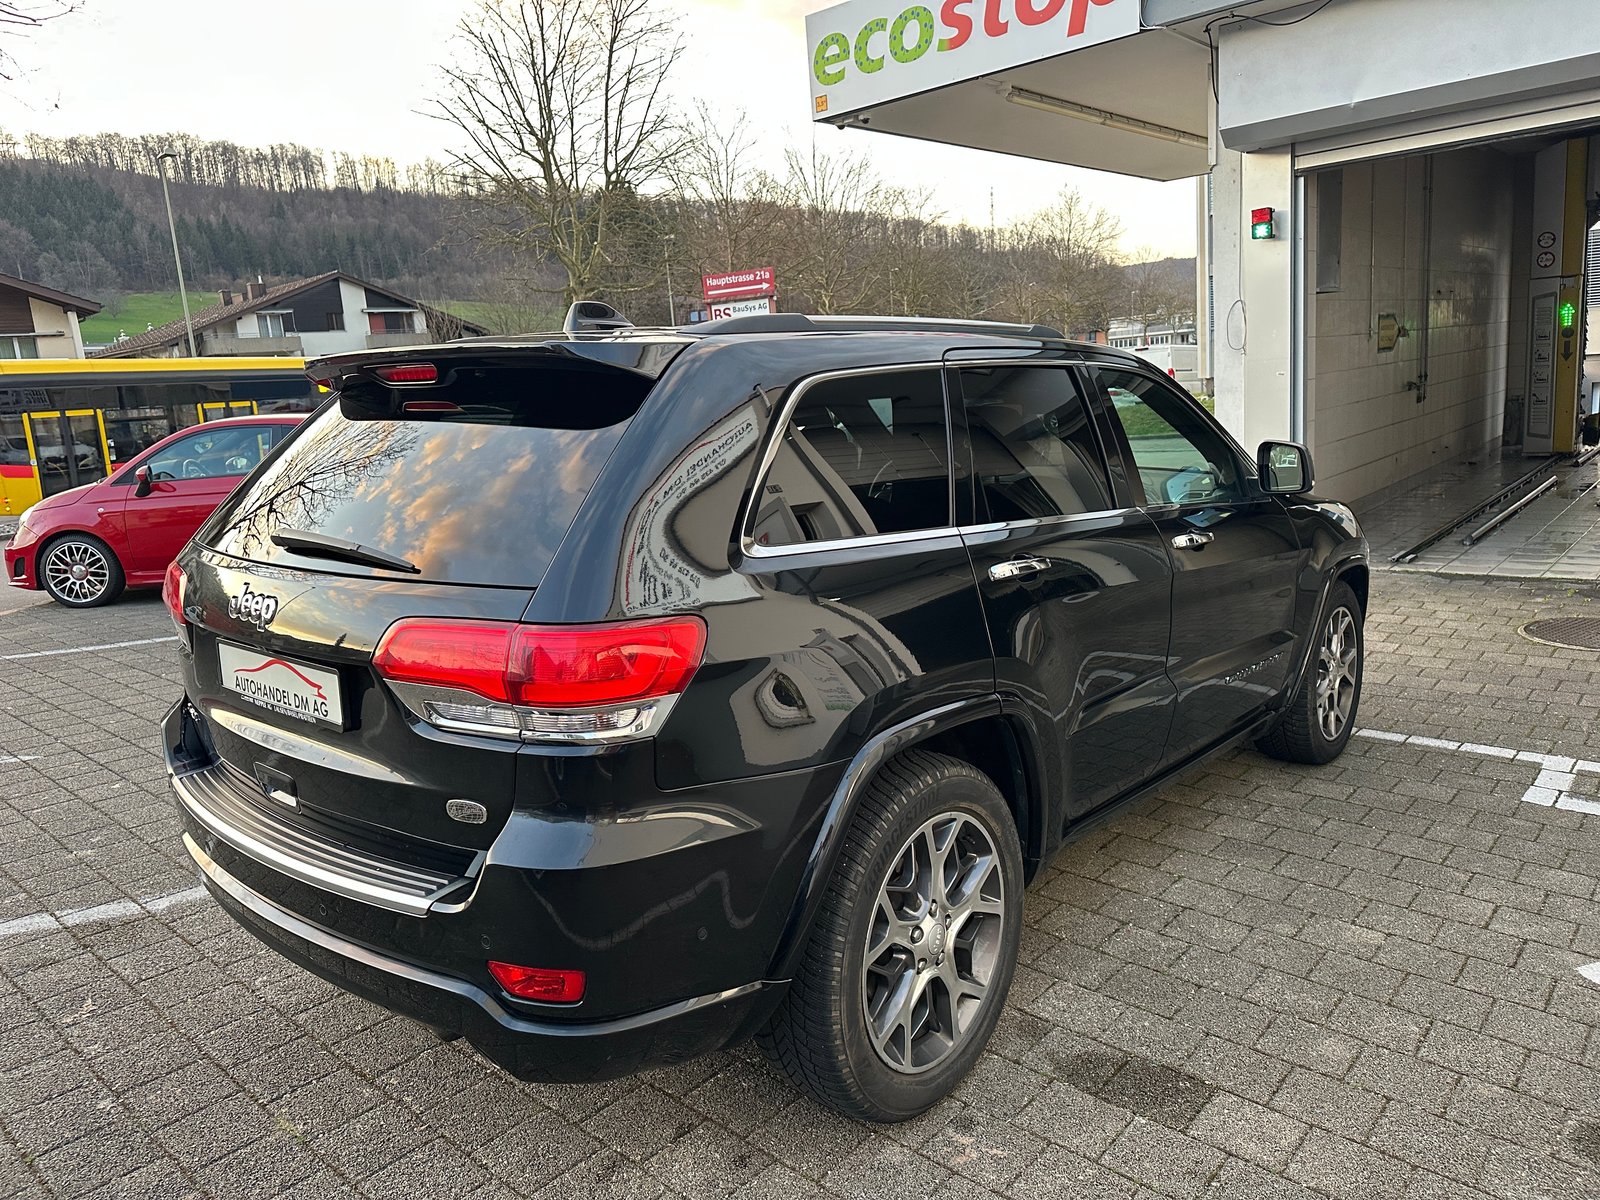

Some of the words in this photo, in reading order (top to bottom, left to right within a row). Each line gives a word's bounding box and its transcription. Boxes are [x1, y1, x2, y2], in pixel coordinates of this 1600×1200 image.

[706, 273, 754, 286] Hauptstrasse
[755, 270, 770, 280] 21a
[733, 304, 756, 313] BauSys
[758, 302, 768, 310] AG
[229, 582, 278, 632] Jeep
[235, 675, 292, 707] AUTOHANDEL
[293, 693, 310, 713] DM
[313, 699, 329, 718] AG
